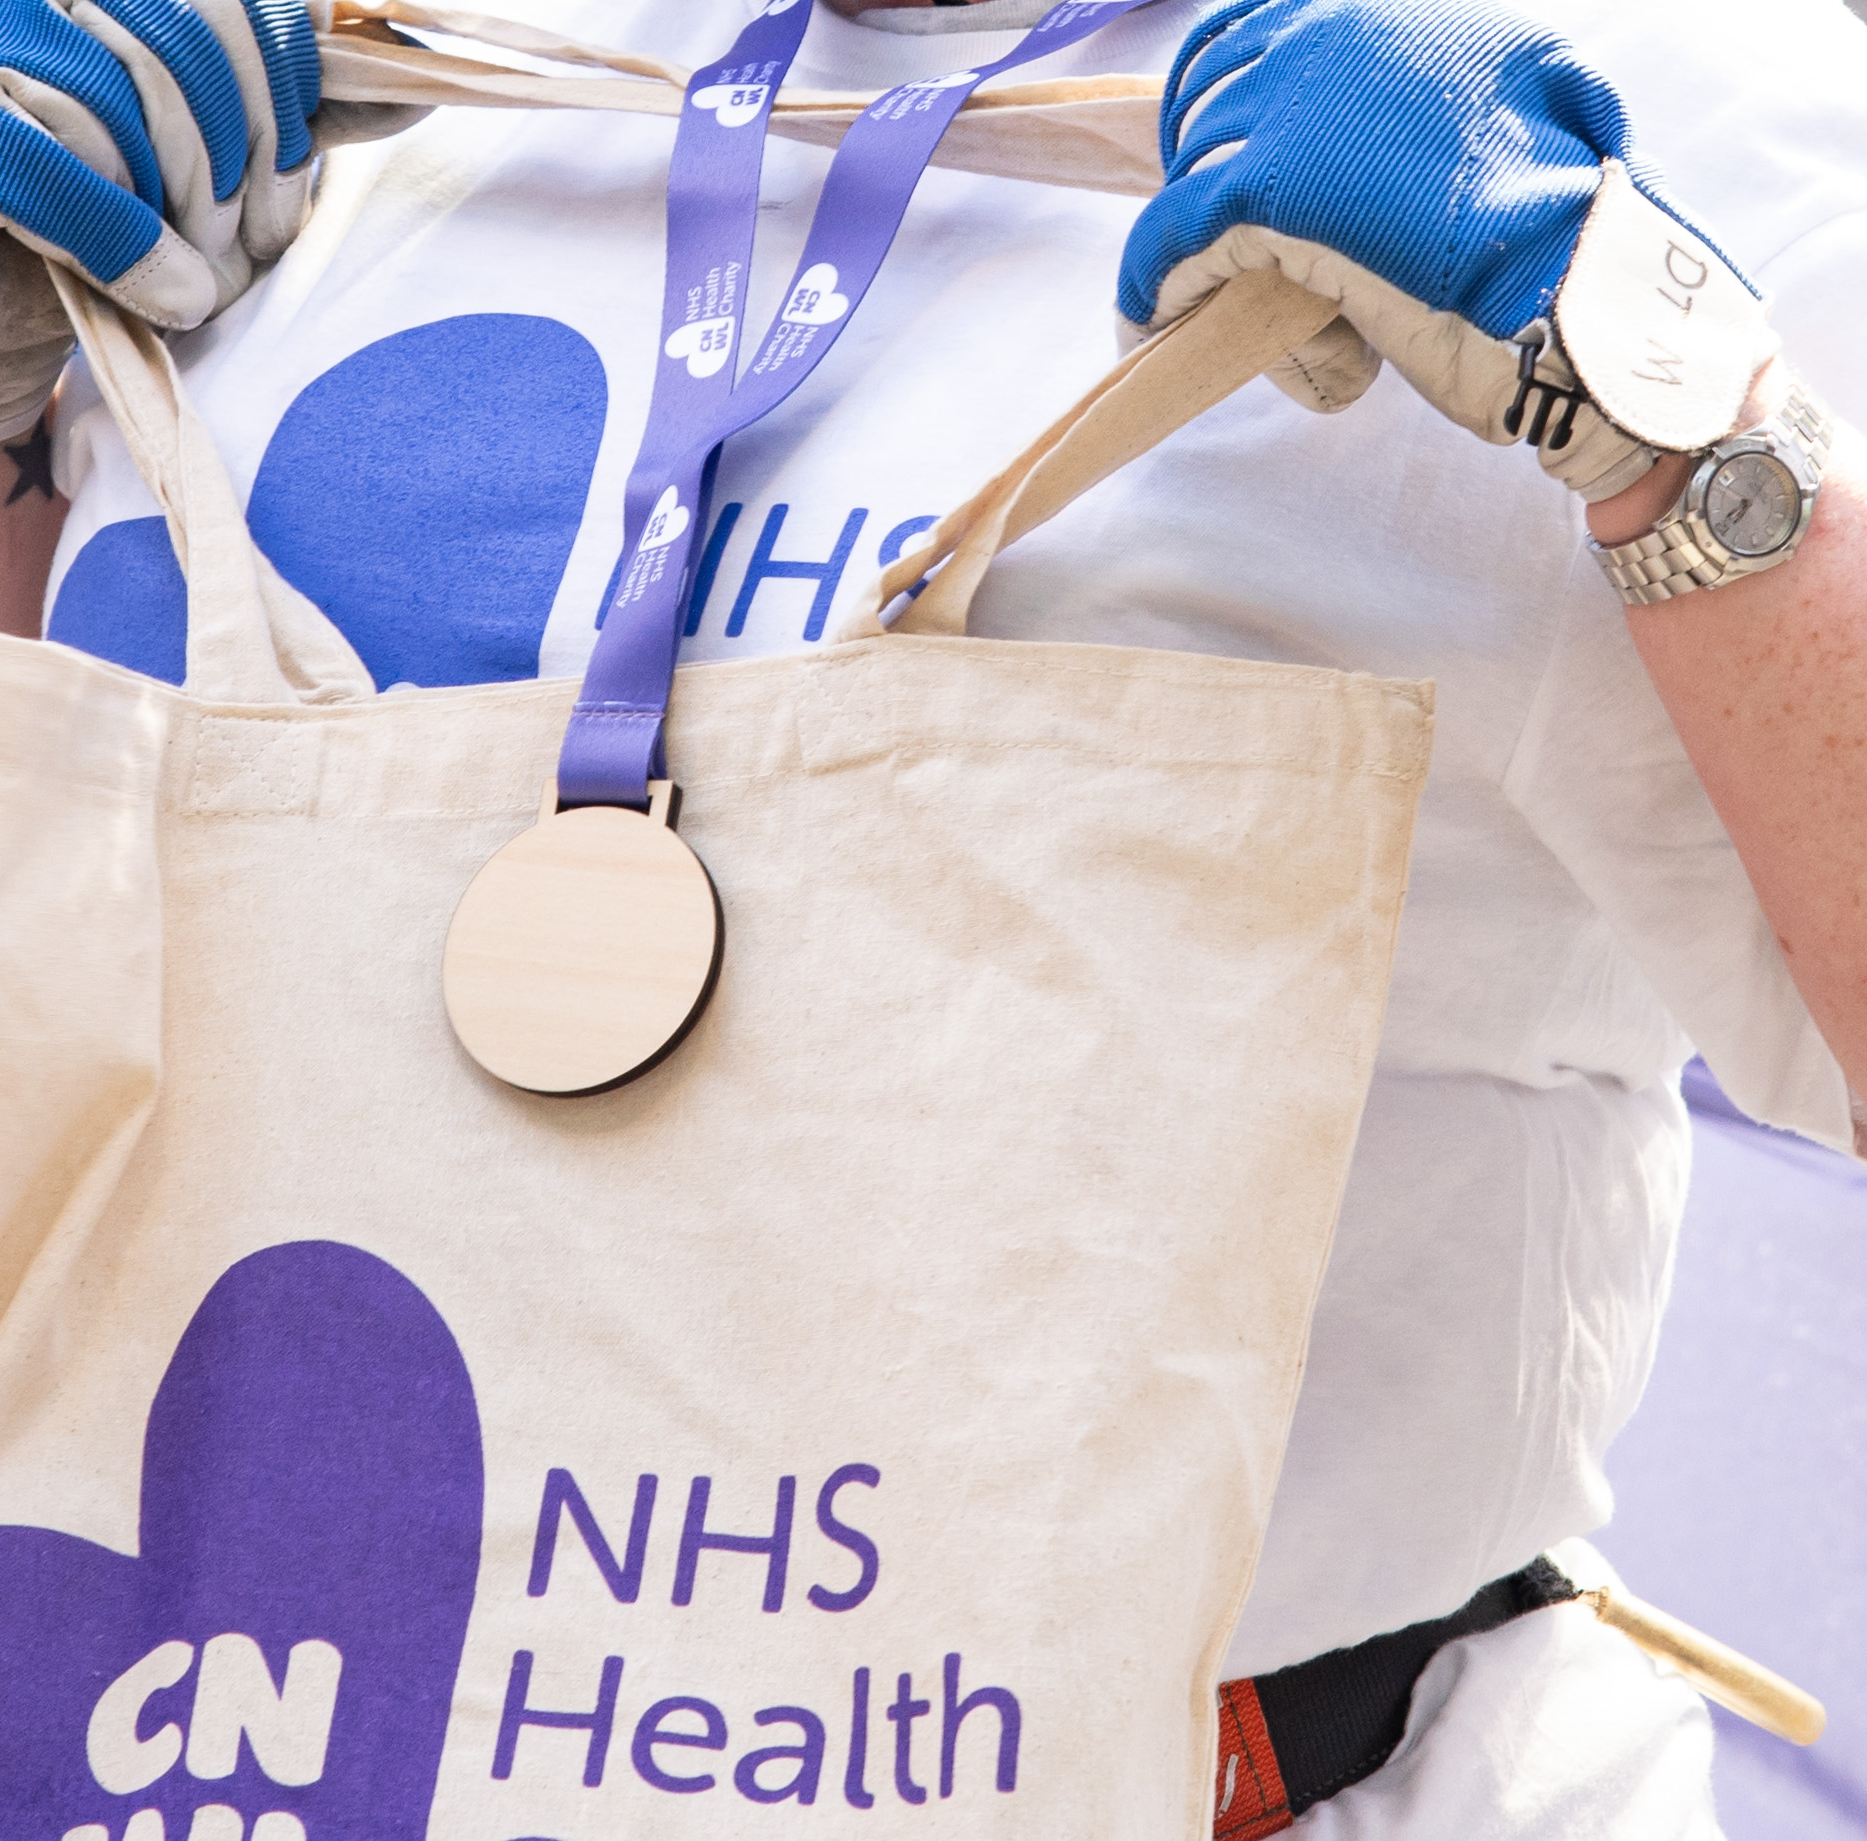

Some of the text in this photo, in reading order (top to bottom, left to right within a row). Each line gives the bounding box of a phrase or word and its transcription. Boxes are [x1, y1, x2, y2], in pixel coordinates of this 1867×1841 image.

[685, 286, 702, 322] NHS
[701, 267, 721, 319] Health
[718, 261, 743, 316] Charity
[788, 288, 809, 316] WL
[802, 290, 821, 313] CN
[700, 329, 714, 353] CN
[714, 322, 729, 351] WL
[753, 322, 792, 375] Charity
[768, 325, 805, 371] Health
[790, 326, 819, 358] NHS
[616, 553, 645, 608] Charity
[632, 549, 657, 602] Health
[650, 545, 670, 583] NHS
[527, 1462, 881, 1613] NHS
[86, 1632, 344, 1795] CN
[491, 1649, 1022, 1809] Health
